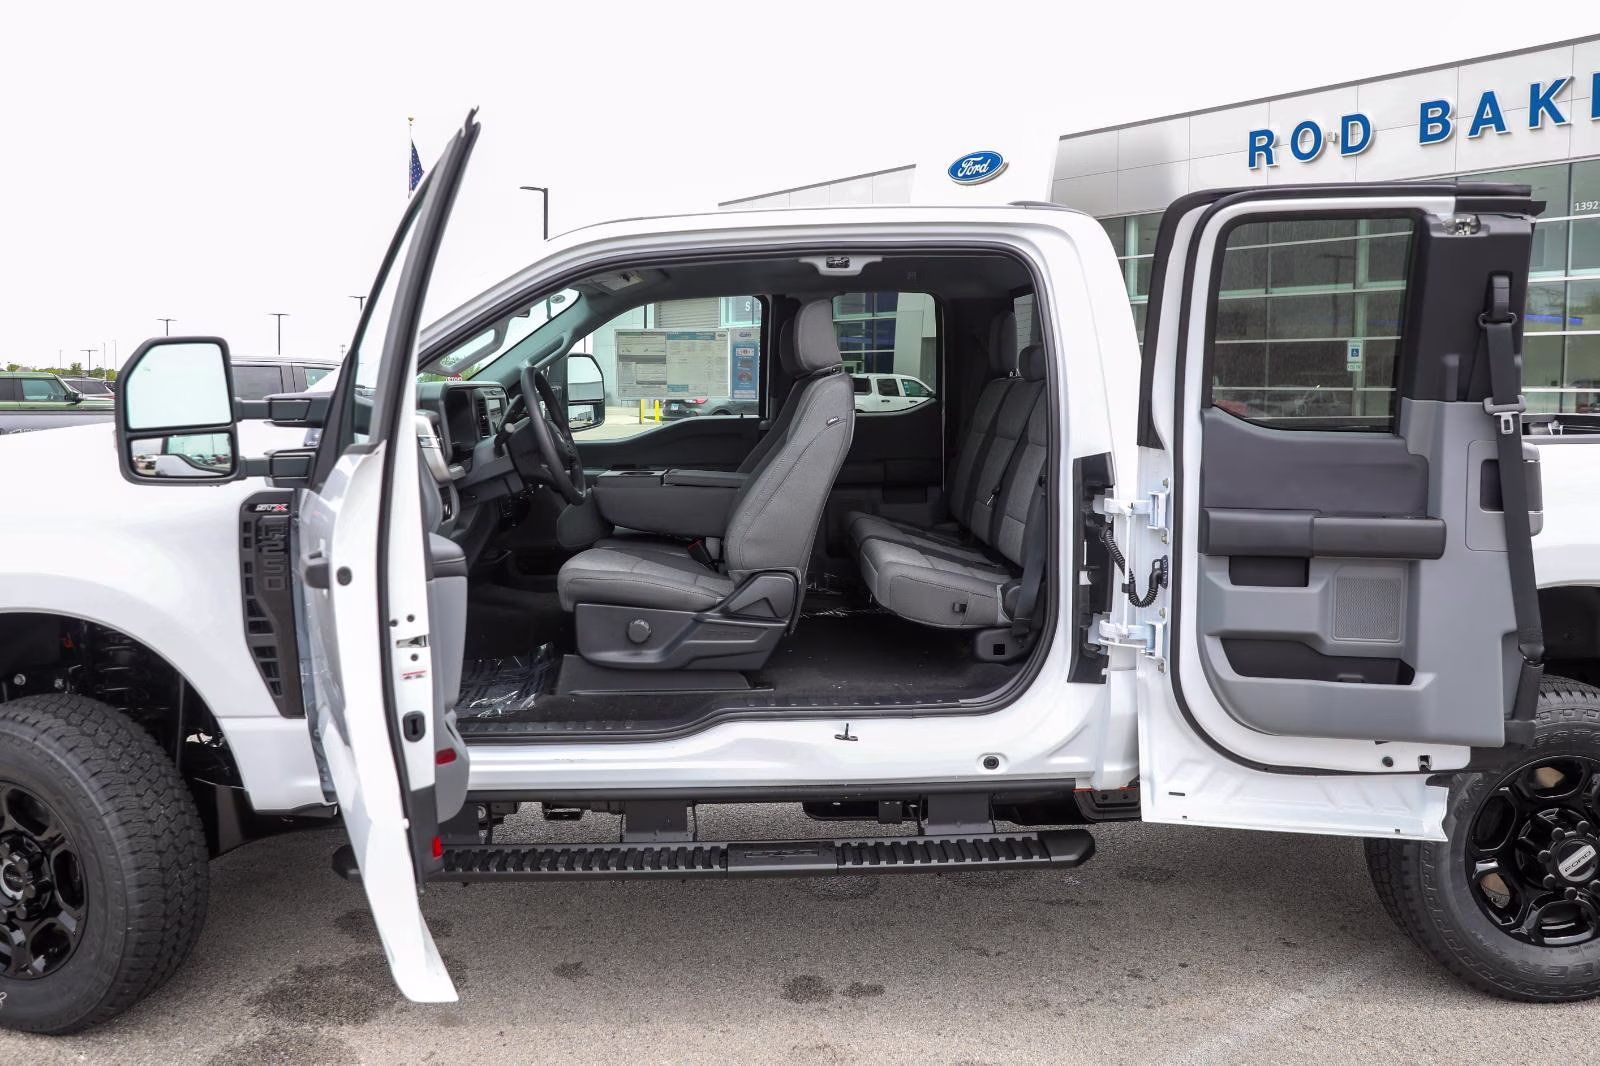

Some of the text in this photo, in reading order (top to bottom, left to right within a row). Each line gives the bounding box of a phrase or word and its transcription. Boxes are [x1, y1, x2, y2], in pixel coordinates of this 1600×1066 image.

[1248, 112, 1374, 169] ROD
[957, 156, 992, 177] Ford
[1575, 200, 1600, 212] 1392
[1564, 850, 1592, 872] FORD
